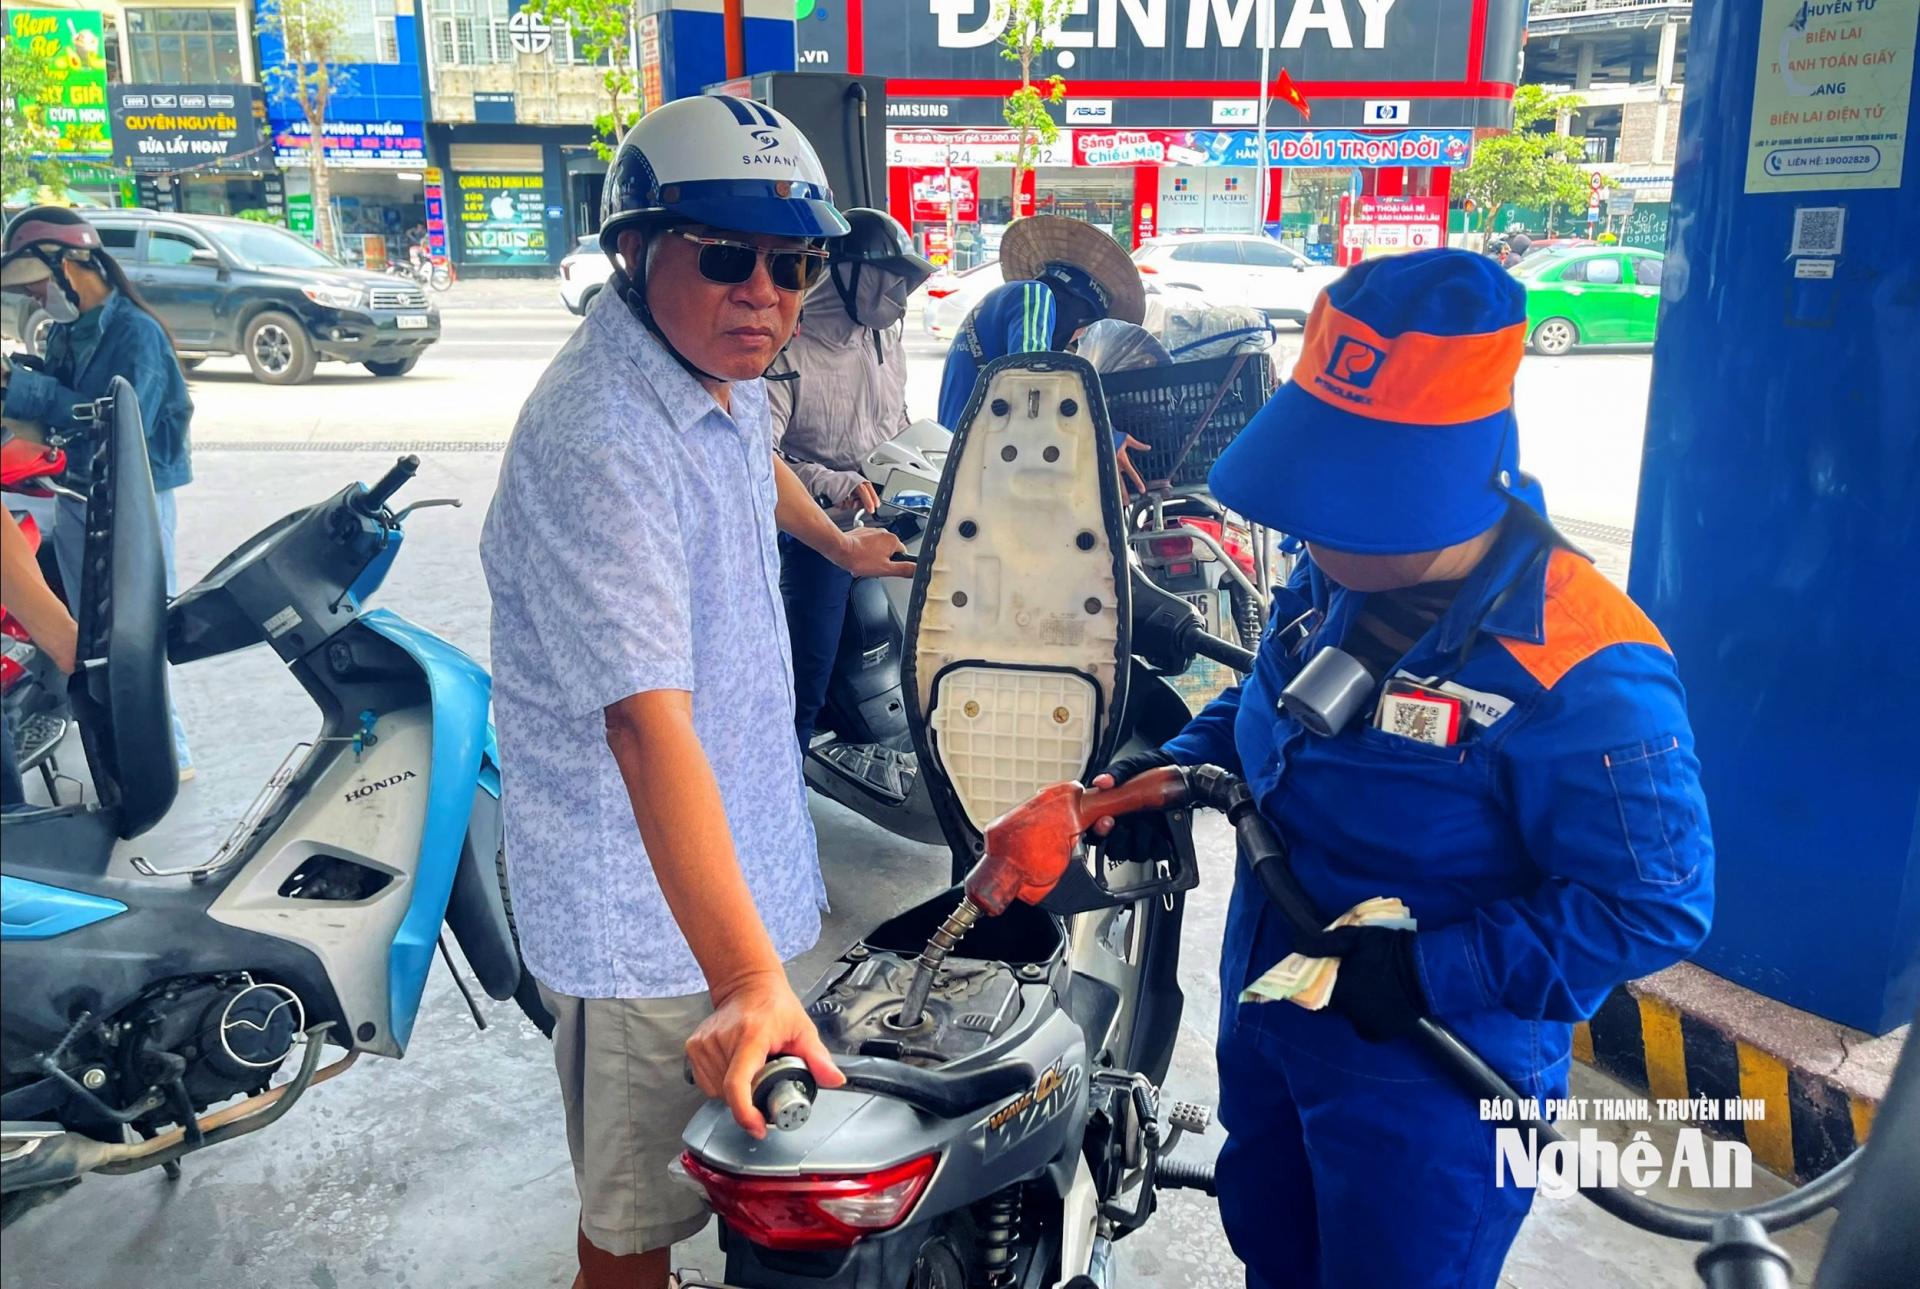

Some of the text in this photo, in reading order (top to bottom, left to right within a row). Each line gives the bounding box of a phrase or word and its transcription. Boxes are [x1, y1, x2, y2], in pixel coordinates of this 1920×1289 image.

[1806, 27, 1862, 44] BIÊN LAI
[1821, 55, 1858, 69] TOÁN
[1863, 50, 1897, 66] GIẤY
[1810, 82, 1846, 96] ANG
[1073, 107, 1106, 116] ASUS
[1770, 113, 1799, 126] BIÊN
[1802, 111, 1822, 123] LAI
[1826, 106, 1860, 121] ĐIỆN
[1118, 133, 1146, 145] Mua
[1339, 140, 1397, 164] TRỌN
[1162, 194, 1199, 202] PACIFIC
[1212, 194, 1248, 202] PACIFIC
[345, 770, 417, 803] HONDA
